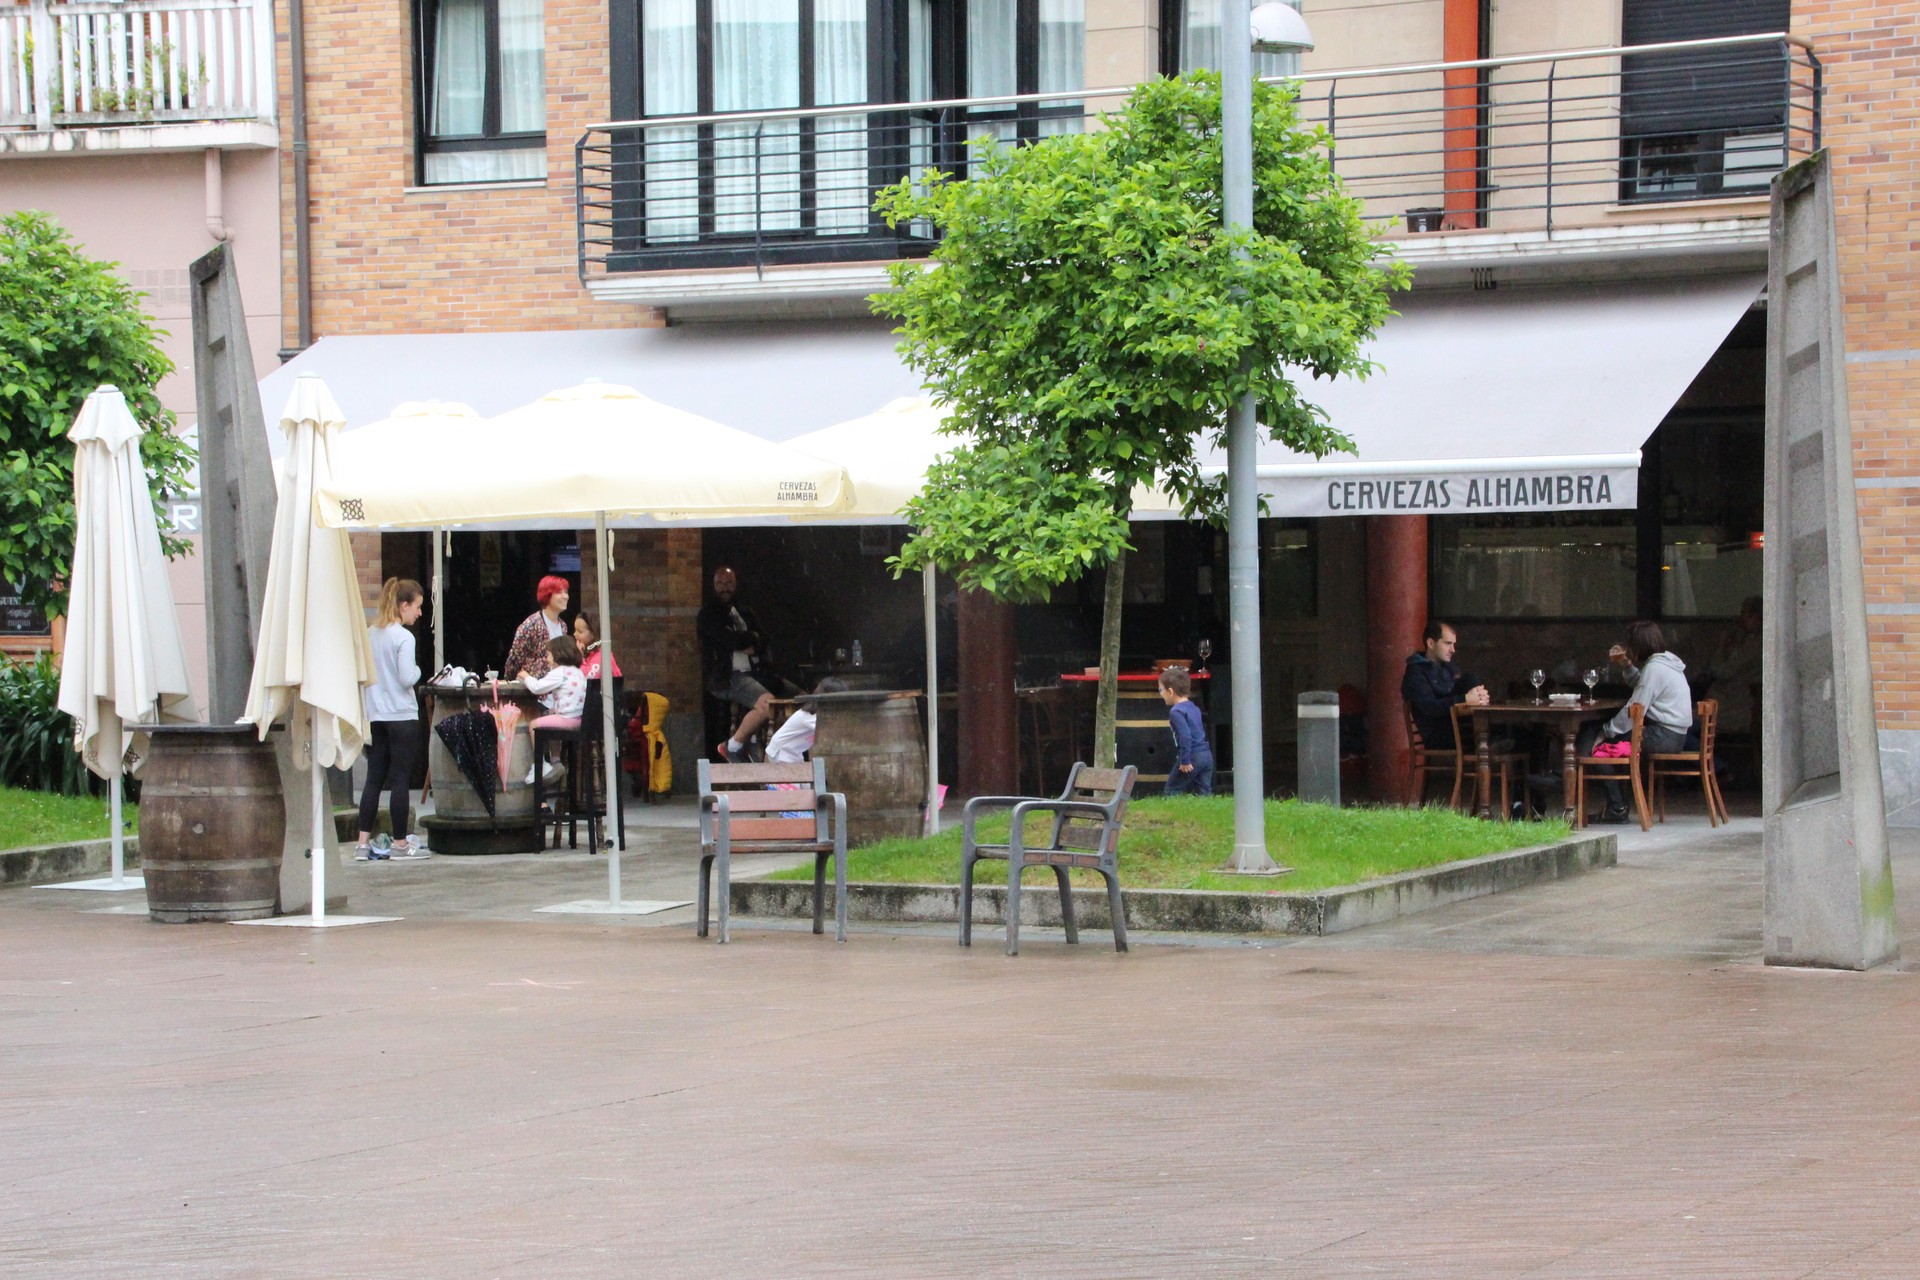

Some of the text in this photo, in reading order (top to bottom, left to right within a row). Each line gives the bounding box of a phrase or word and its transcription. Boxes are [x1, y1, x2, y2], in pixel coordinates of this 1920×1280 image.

[779, 481, 817, 491] CERVEZAS
[777, 491, 818, 501] ALHAMBRA
[1328, 475, 1613, 510] CERVEZAS ALHAMBRA
